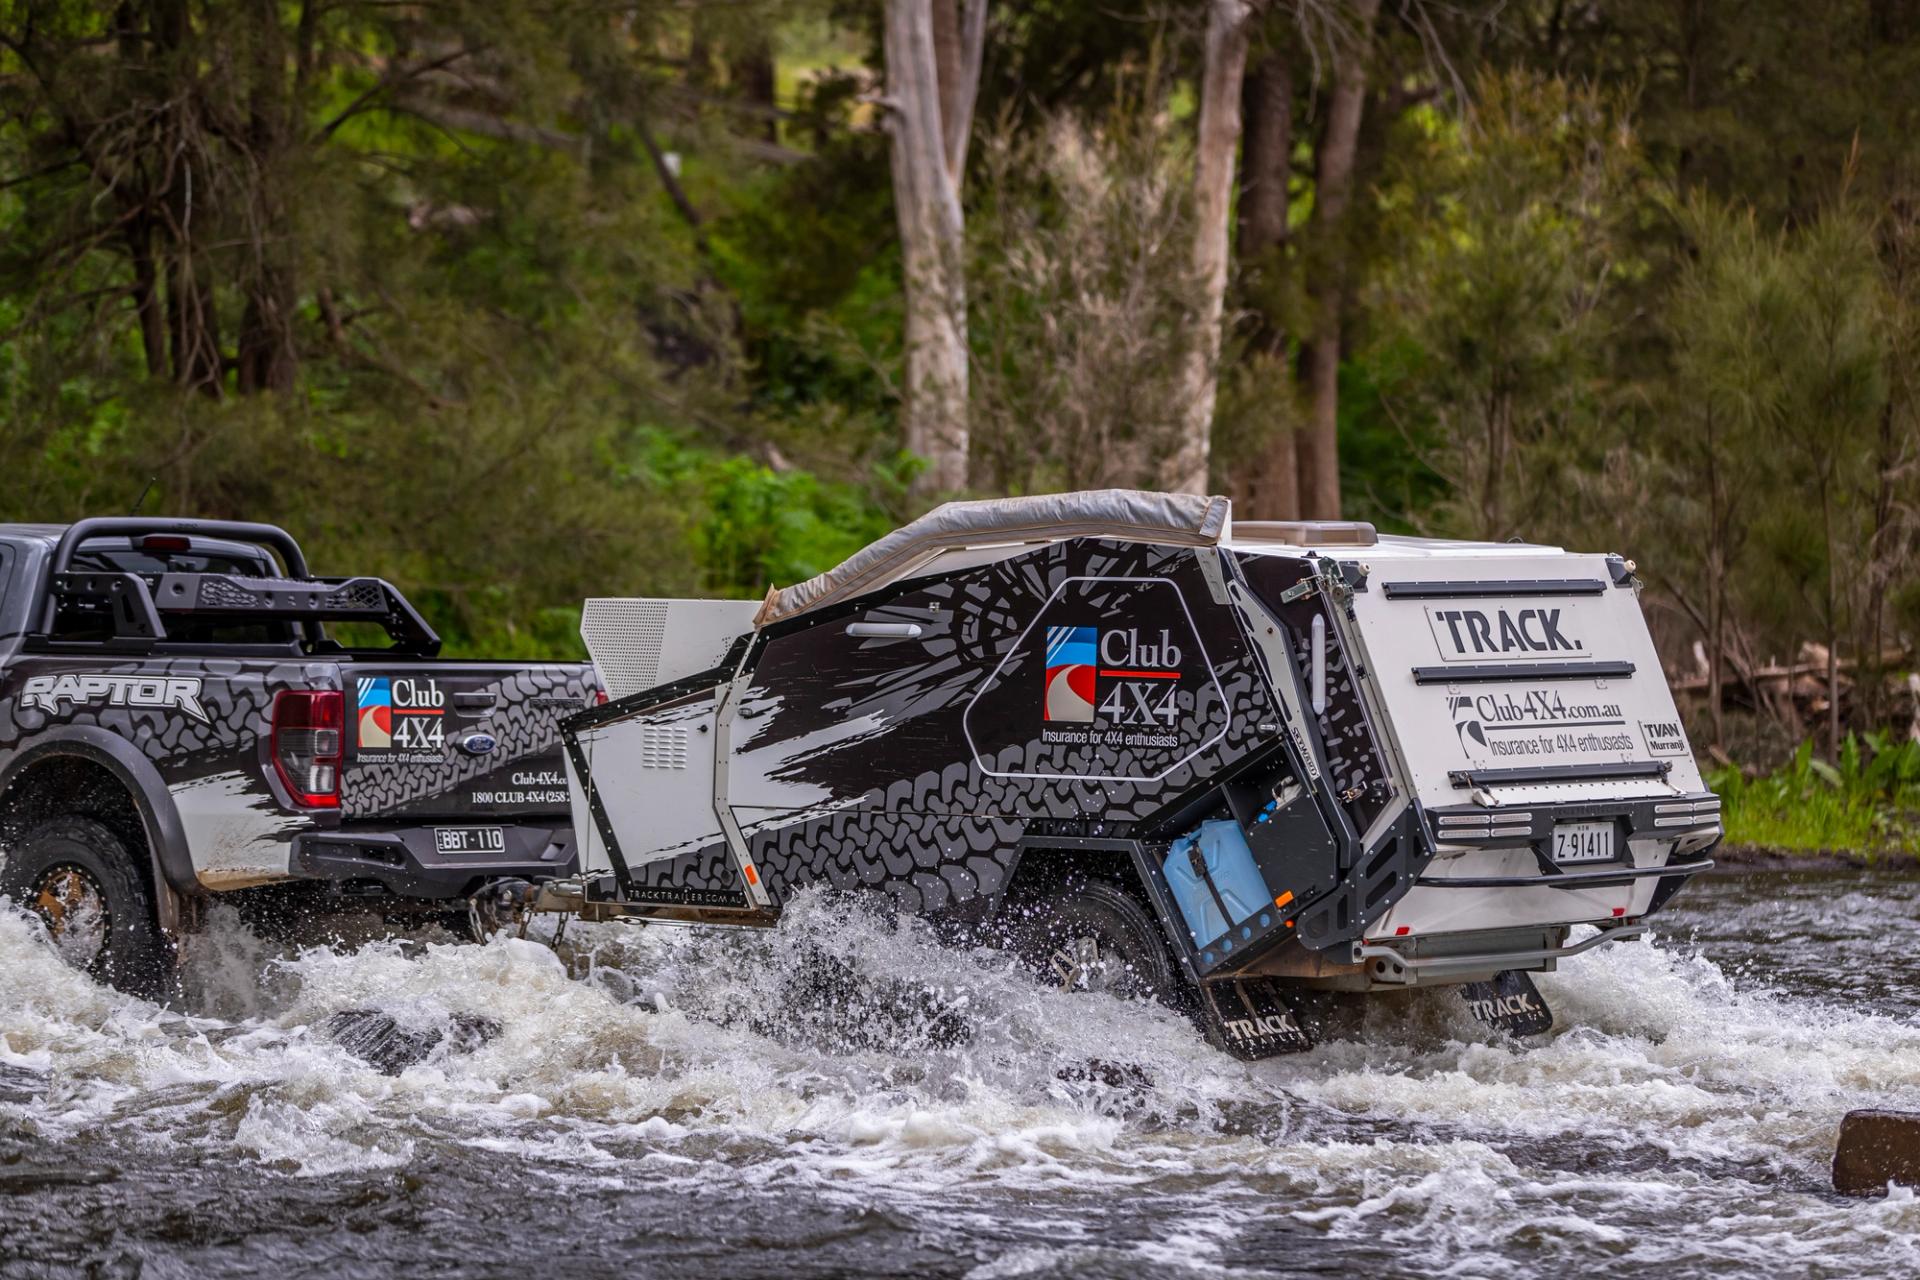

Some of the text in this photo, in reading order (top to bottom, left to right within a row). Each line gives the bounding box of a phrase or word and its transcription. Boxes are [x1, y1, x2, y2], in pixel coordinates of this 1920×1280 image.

[1101, 628, 1182, 668] Club
[21, 674, 211, 724] RAPTOR
[392, 678, 445, 707] Club
[1098, 682, 1180, 726] 4X4
[1476, 690, 1623, 722] Club4X4.com.au
[393, 717, 445, 748] 4X4
[1043, 729, 1178, 747] Insurance for 4X4 enthusiasts
[1644, 723, 1680, 738] TVAN
[1488, 732, 1634, 756] Insurance for 4X4 enthusiasts
[1650, 740, 1684, 751] Murranji
[357, 753, 444, 763] Insurance for 4X4 enthusiasts
[472, 791, 493, 803] 1800
[495, 791, 524, 803] CLUB
[525, 790, 545, 802] 4X4
